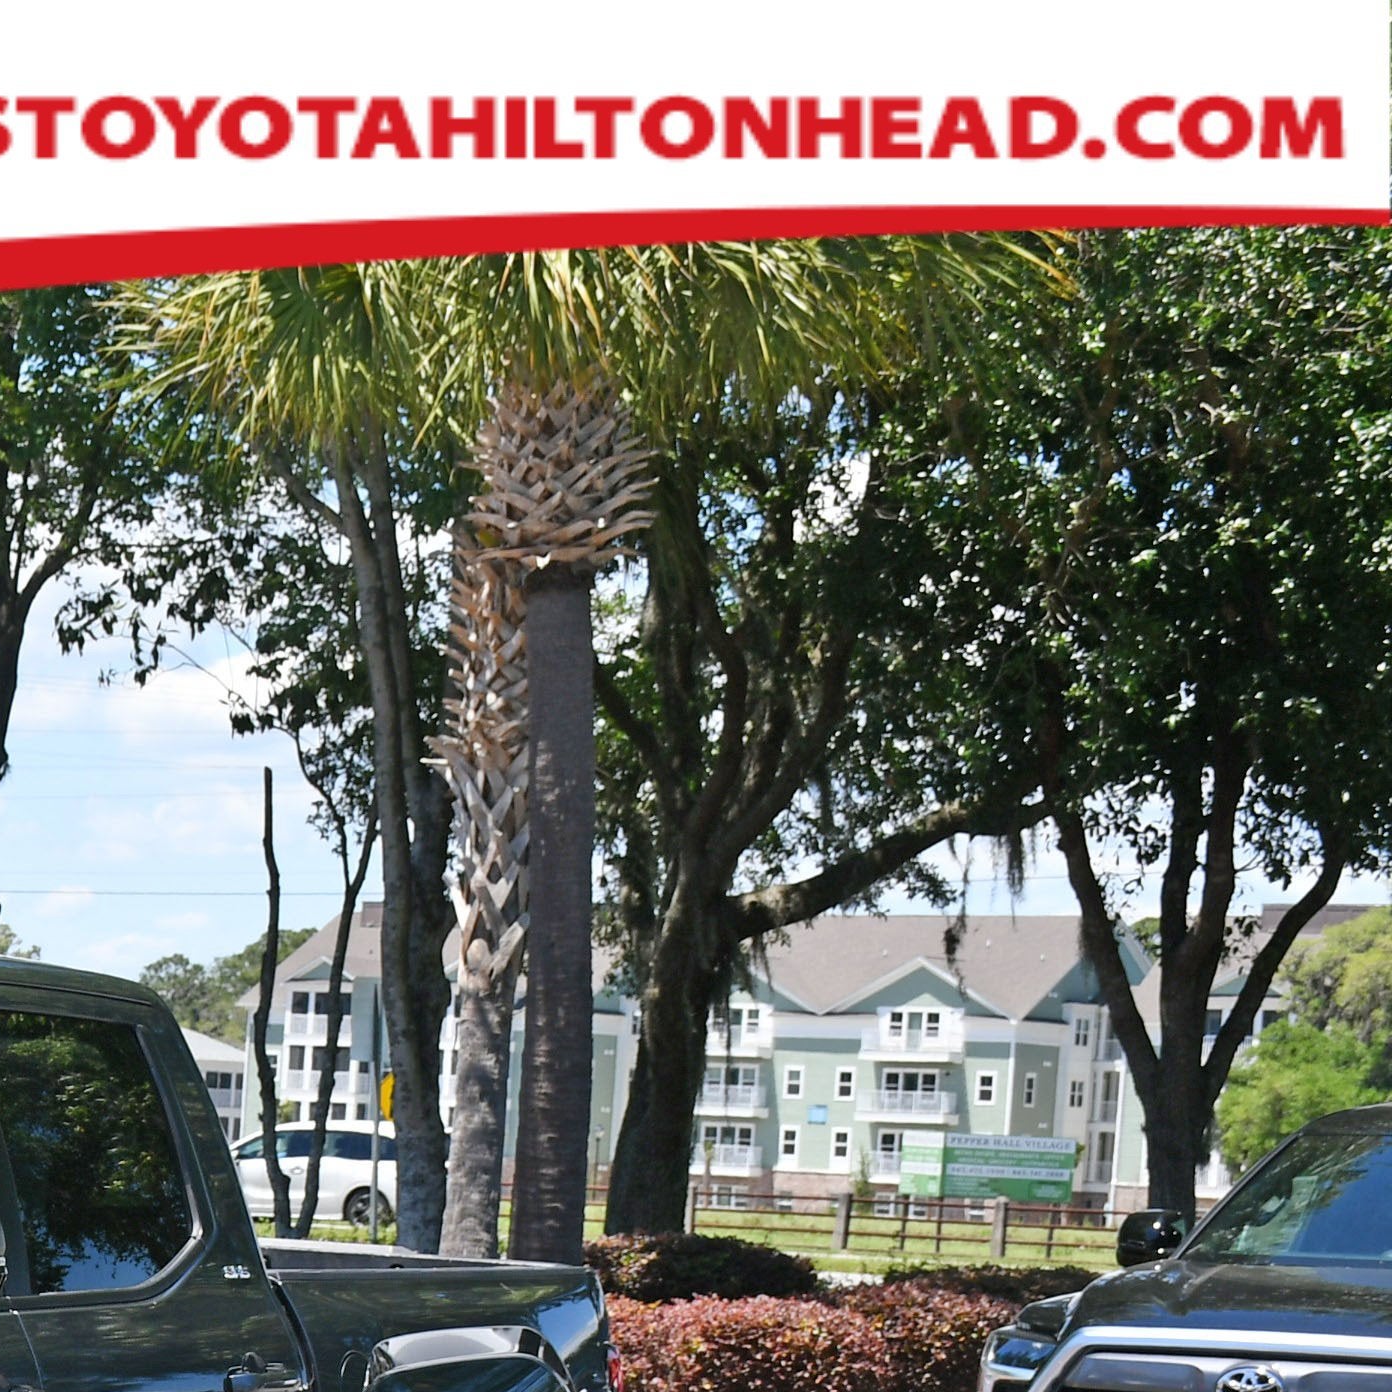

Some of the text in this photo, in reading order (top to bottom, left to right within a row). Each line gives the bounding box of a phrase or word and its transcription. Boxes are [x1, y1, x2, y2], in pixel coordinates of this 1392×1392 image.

[950, 1136, 1071, 1150] PEPPER HALL VILLAGE
